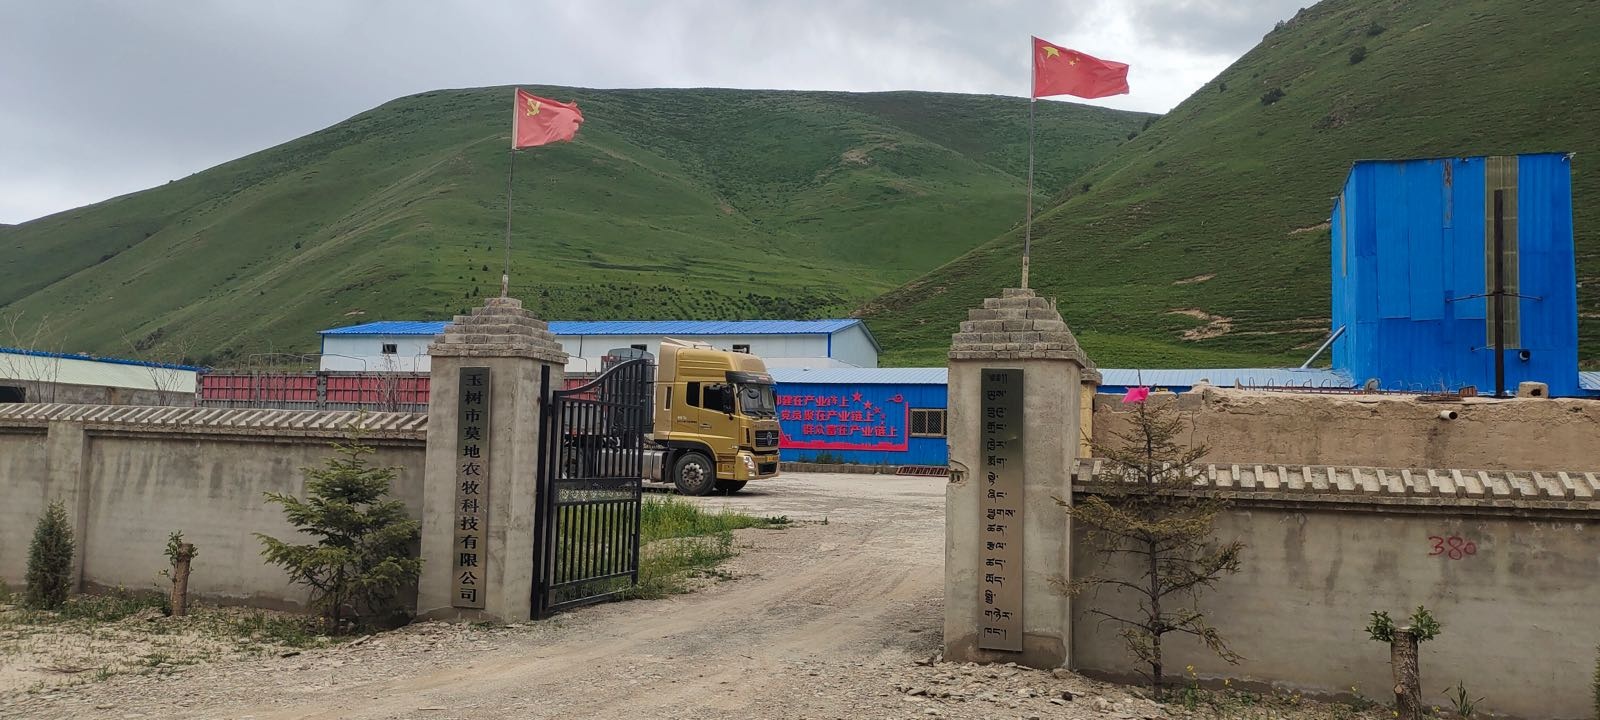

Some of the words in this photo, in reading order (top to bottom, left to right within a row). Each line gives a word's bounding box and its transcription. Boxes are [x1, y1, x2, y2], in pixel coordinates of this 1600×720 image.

[781, 409, 874, 421] 党员聚在产业链上
[803, 423, 898, 436] 群众富在产业链上
[458, 374, 484, 603] 玉树市莫地农牧科技有限公司
[1428, 535, 1477, 560] 380
